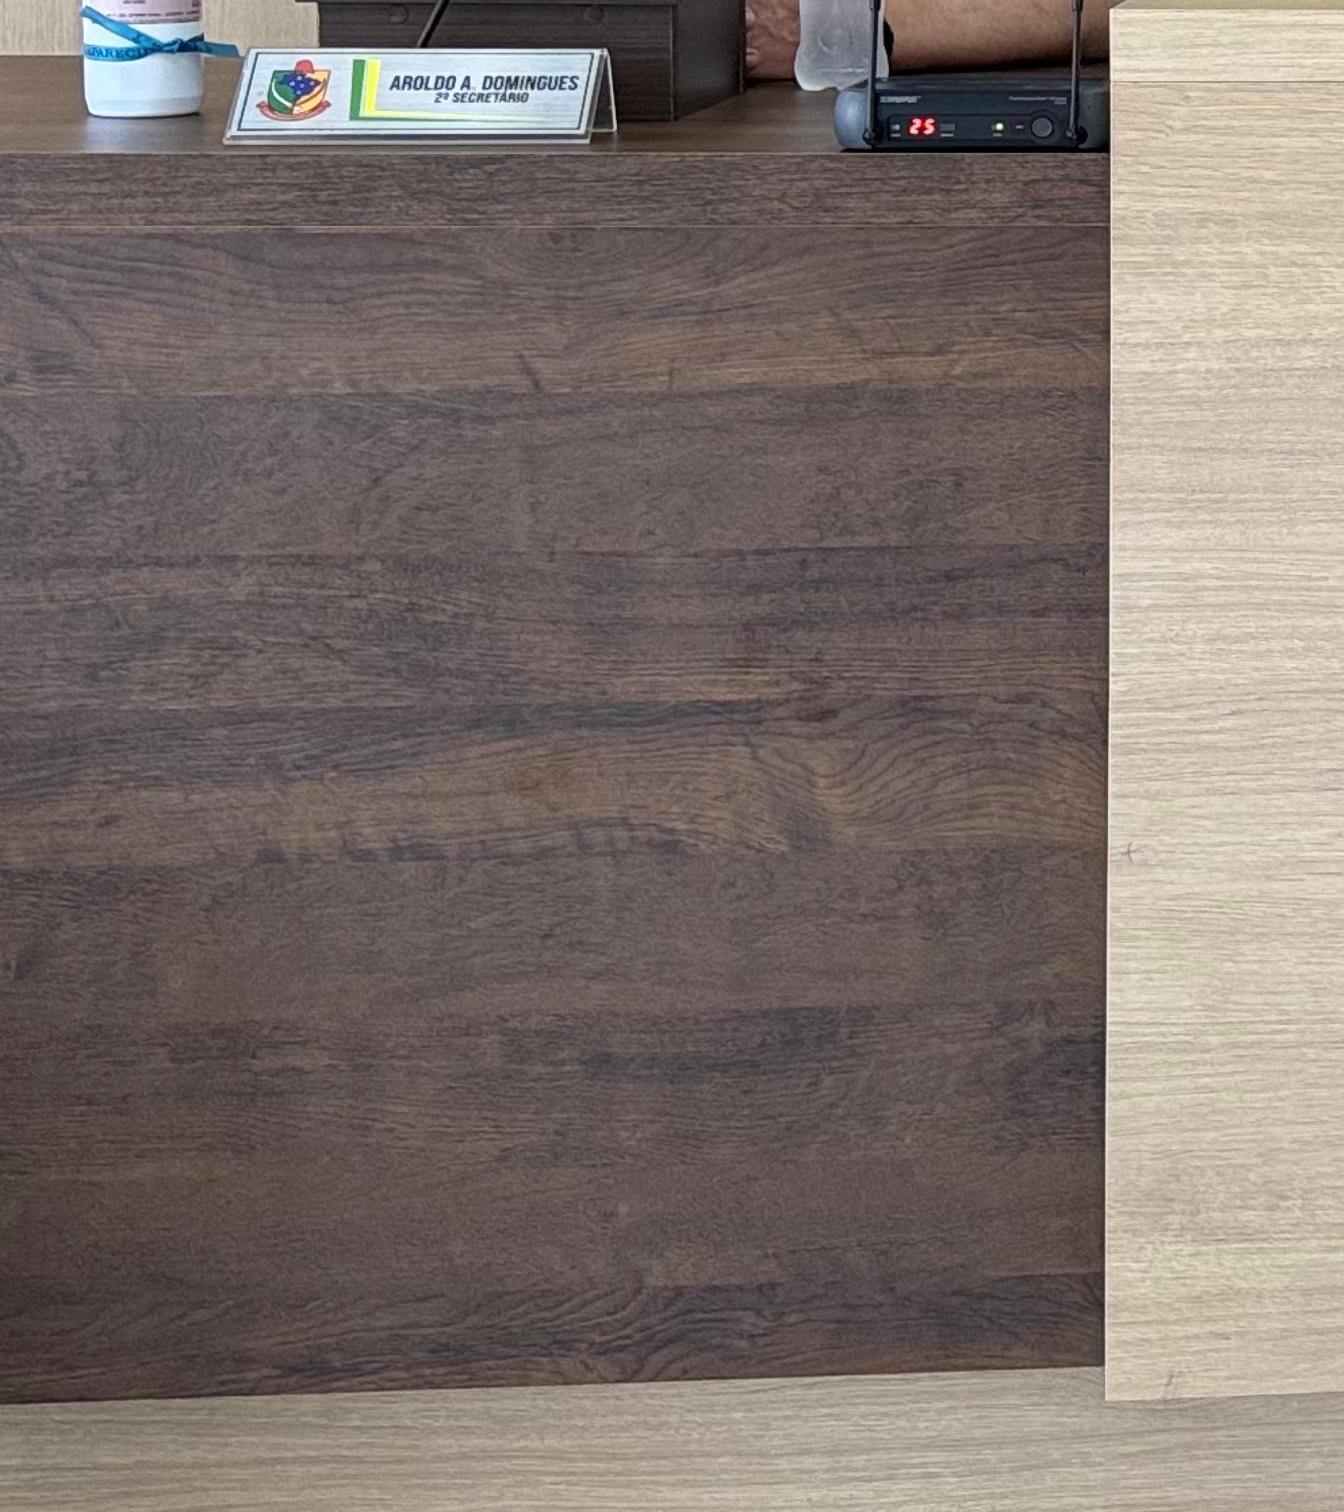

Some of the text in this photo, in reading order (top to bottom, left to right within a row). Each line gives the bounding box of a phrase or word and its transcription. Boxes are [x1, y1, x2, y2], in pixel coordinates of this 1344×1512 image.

[389, 75, 580, 91] AROLDO A. DOMINGUES
[452, 90, 530, 104] SECRETÁRIO
[909, 118, 936, 135] 25
